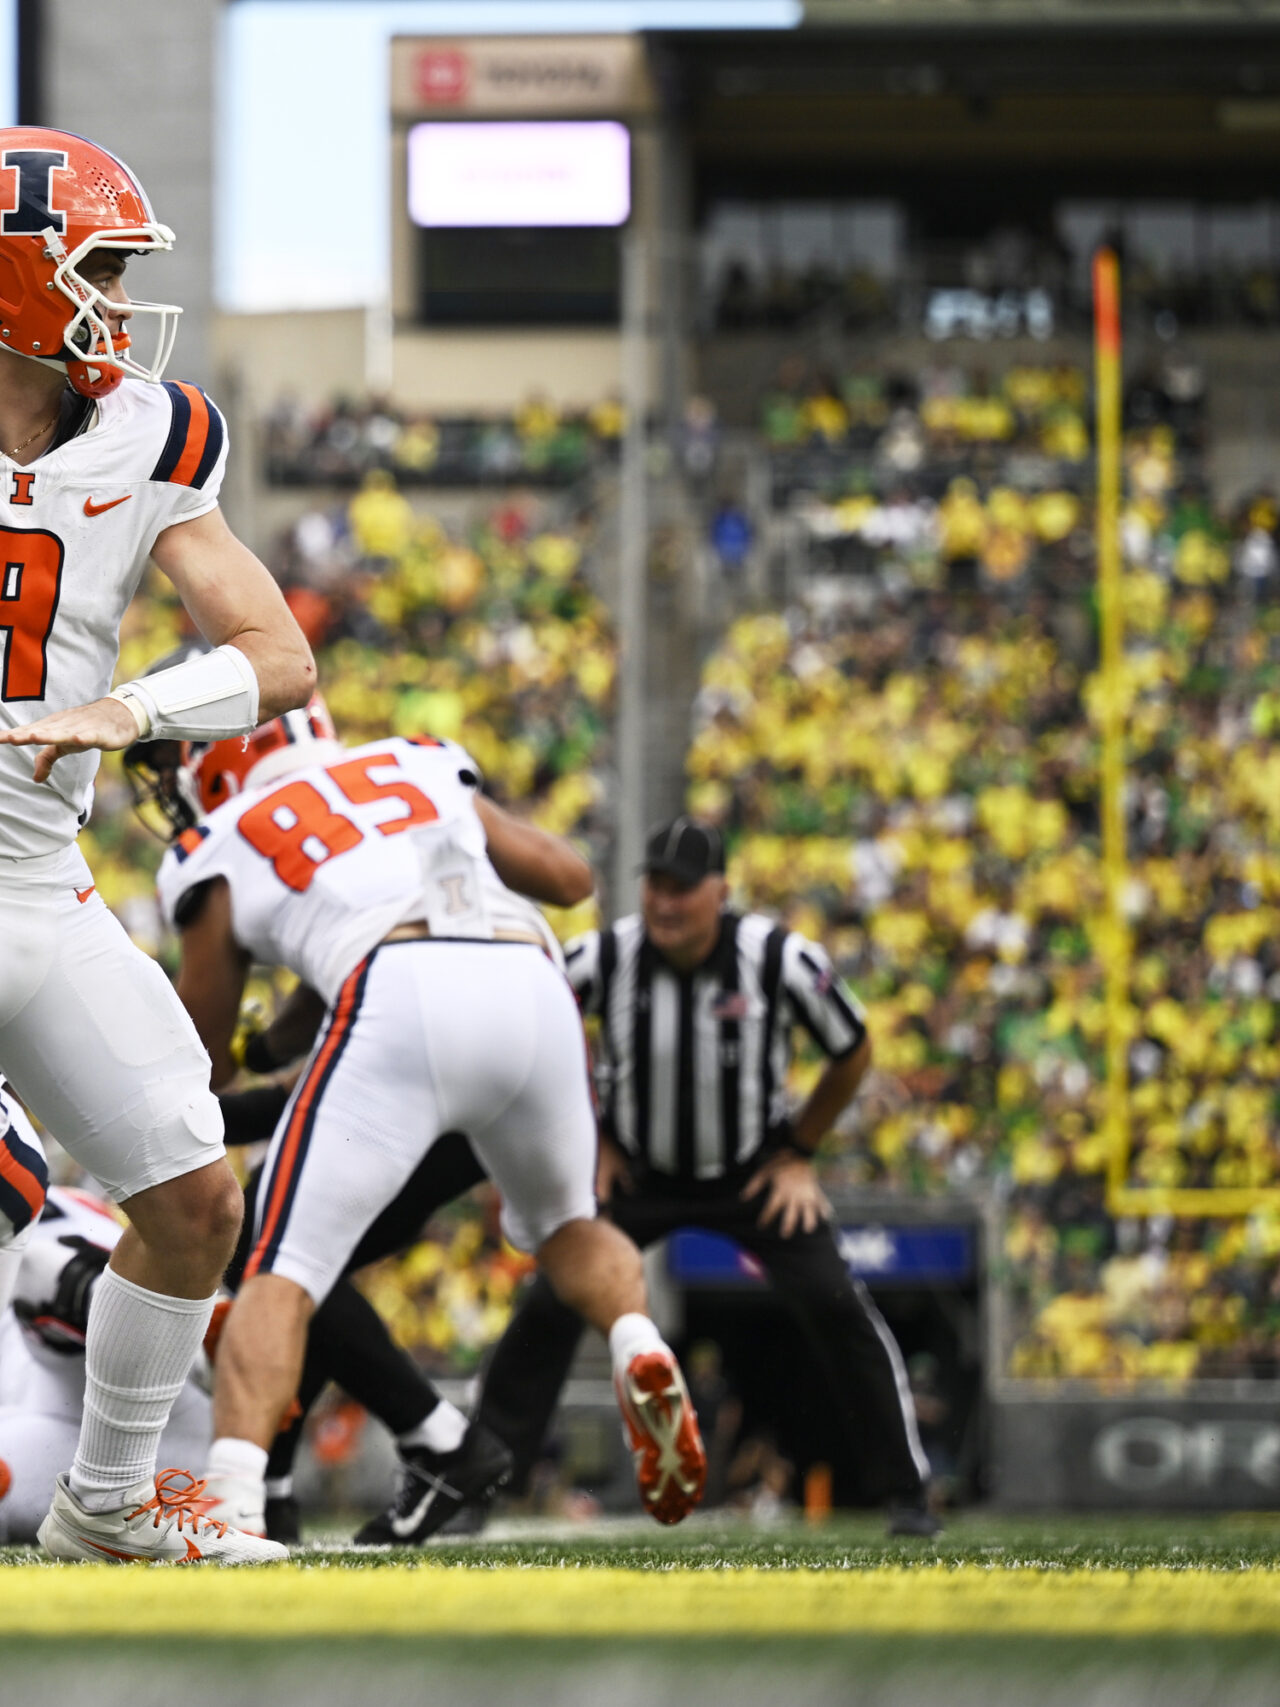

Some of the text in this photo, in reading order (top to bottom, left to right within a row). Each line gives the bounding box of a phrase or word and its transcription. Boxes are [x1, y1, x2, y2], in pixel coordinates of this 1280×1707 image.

[0, 149, 68, 236] I
[9, 472, 36, 506] I
[237, 752, 440, 893] 85
